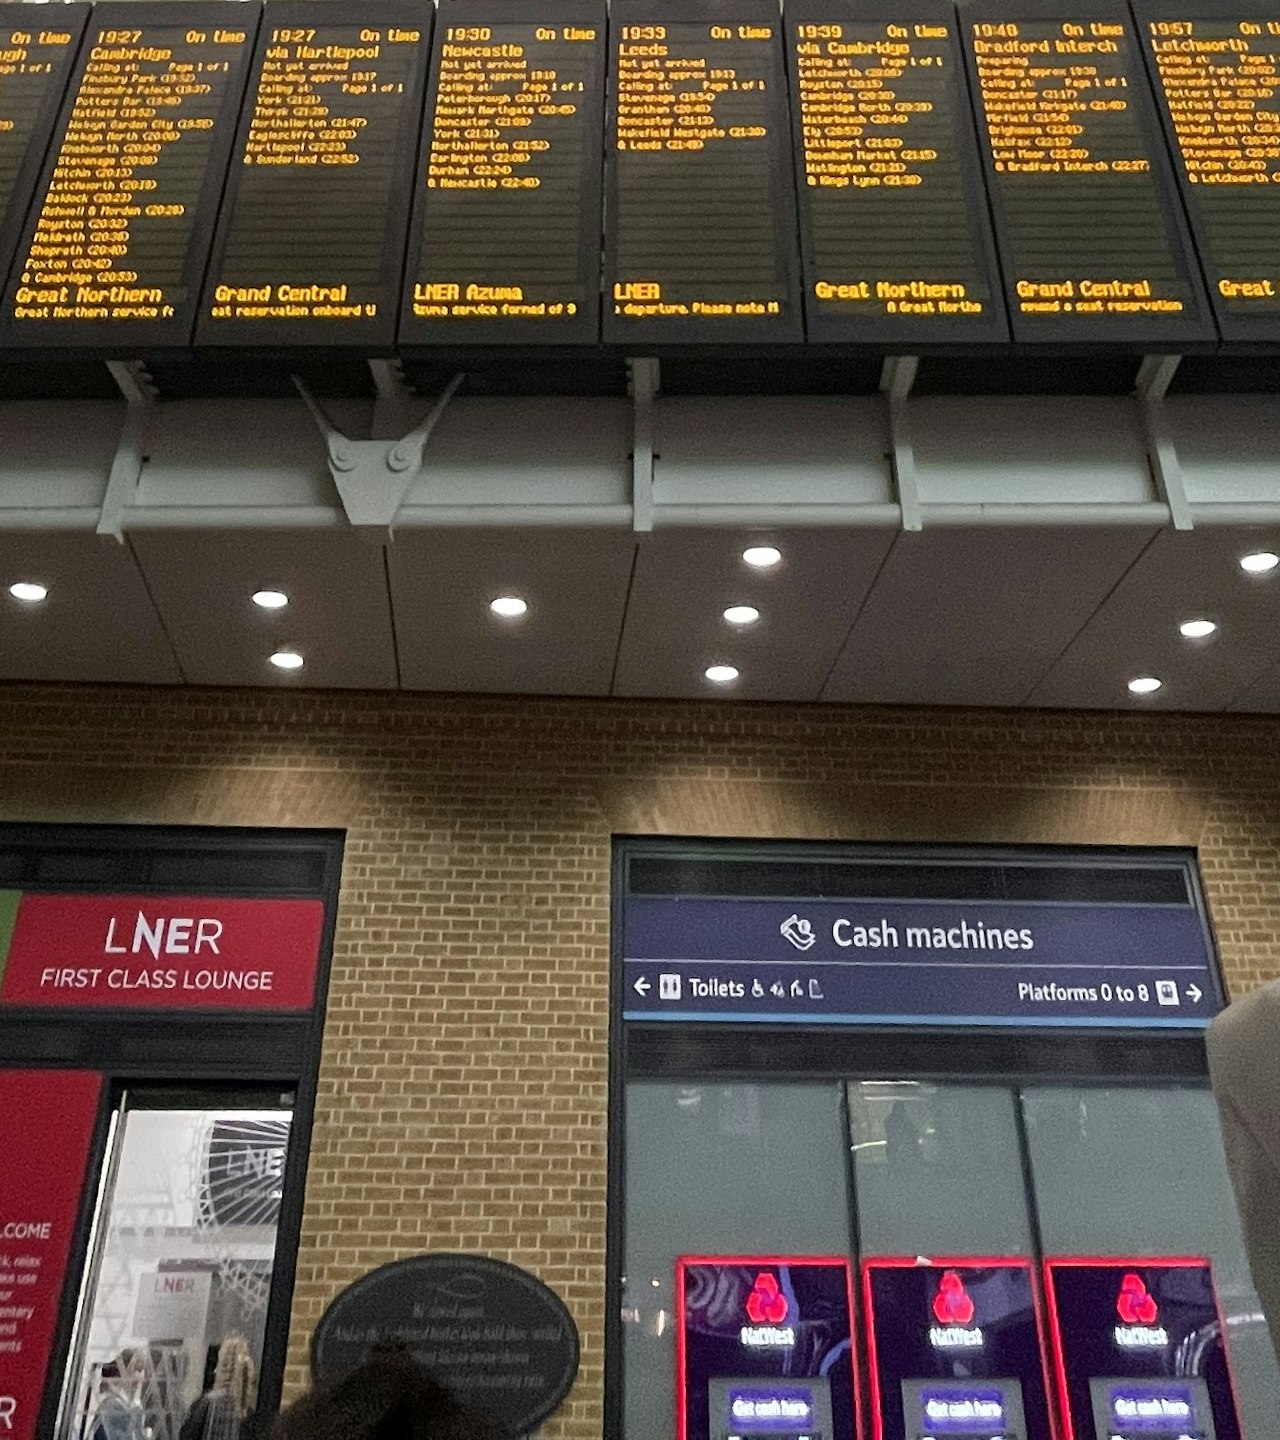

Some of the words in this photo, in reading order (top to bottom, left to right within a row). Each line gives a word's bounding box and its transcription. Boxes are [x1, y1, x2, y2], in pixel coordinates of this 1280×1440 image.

[273, 30, 315, 42] 19:27
[360, 29, 380, 41] On
[388, 29, 420, 41] time
[448, 28, 490, 41] 19:30
[536, 28, 555, 40] On
[563, 28, 595, 40] time
[623, 27, 665, 40] 19:33
[711, 26, 731, 38] On
[738, 26, 771, 38] time
[798, 25, 842, 38] 19:39
[887, 25, 908, 37] On
[914, 25, 947, 37] time
[1063, 24, 1084, 37] On
[1090, 23, 1123, 36] time
[1150, 22, 1192, 35] 19:57
[1240, 22, 1261, 35] On
[11, 32, 31, 44] On
[39, 32, 71, 44] time
[99, 31, 142, 44] 19:27
[186, 31, 206, 43] On
[214, 30, 245, 43] time
[266, 46, 288, 58] via
[296, 46, 379, 60] Hartlepool
[443, 44, 523, 57] Newcastle
[619, 43, 668, 56] Leeds
[797, 42, 820, 55] via
[828, 42, 910, 56] Cambridge
[974, 40, 1049, 54] Bradford
[1055, 40, 1117, 52] Interch
[1152, 39, 1249, 52] Letchworth
[91, 47, 171, 61] Cambridge
[16, 287, 68, 303] Great
[76, 284, 162, 303] Northern
[215, 286, 271, 301] Grand
[278, 285, 346, 302] Central
[414, 284, 459, 300] LNER
[466, 284, 523, 300] Azuma
[614, 283, 660, 299] LNER
[816, 282, 870, 298] Great
[877, 282, 965, 298] Northern
[1017, 281, 1073, 297] Grand
[1080, 281, 1150, 297] Central
[1219, 280, 1275, 296] Great
[105, 910, 223, 960] LNER
[833, 919, 899, 949] Cash
[906, 920, 1034, 951] machines
[41, 968, 100, 989] FIRST
[108, 968, 176, 989] CLASS
[183, 969, 273, 991] LOUNGE
[689, 978, 745, 999] Toilets
[1018, 983, 1098, 1002] Platforms
[1101, 984, 1112, 1002] 0
[1116, 985, 1135, 1002] to
[1138, 985, 1149, 1002] 8
[741, 1326, 794, 1345] NatWest
[929, 1327, 983, 1345] NatWest
[1115, 1326, 1168, 1345] NatWest
